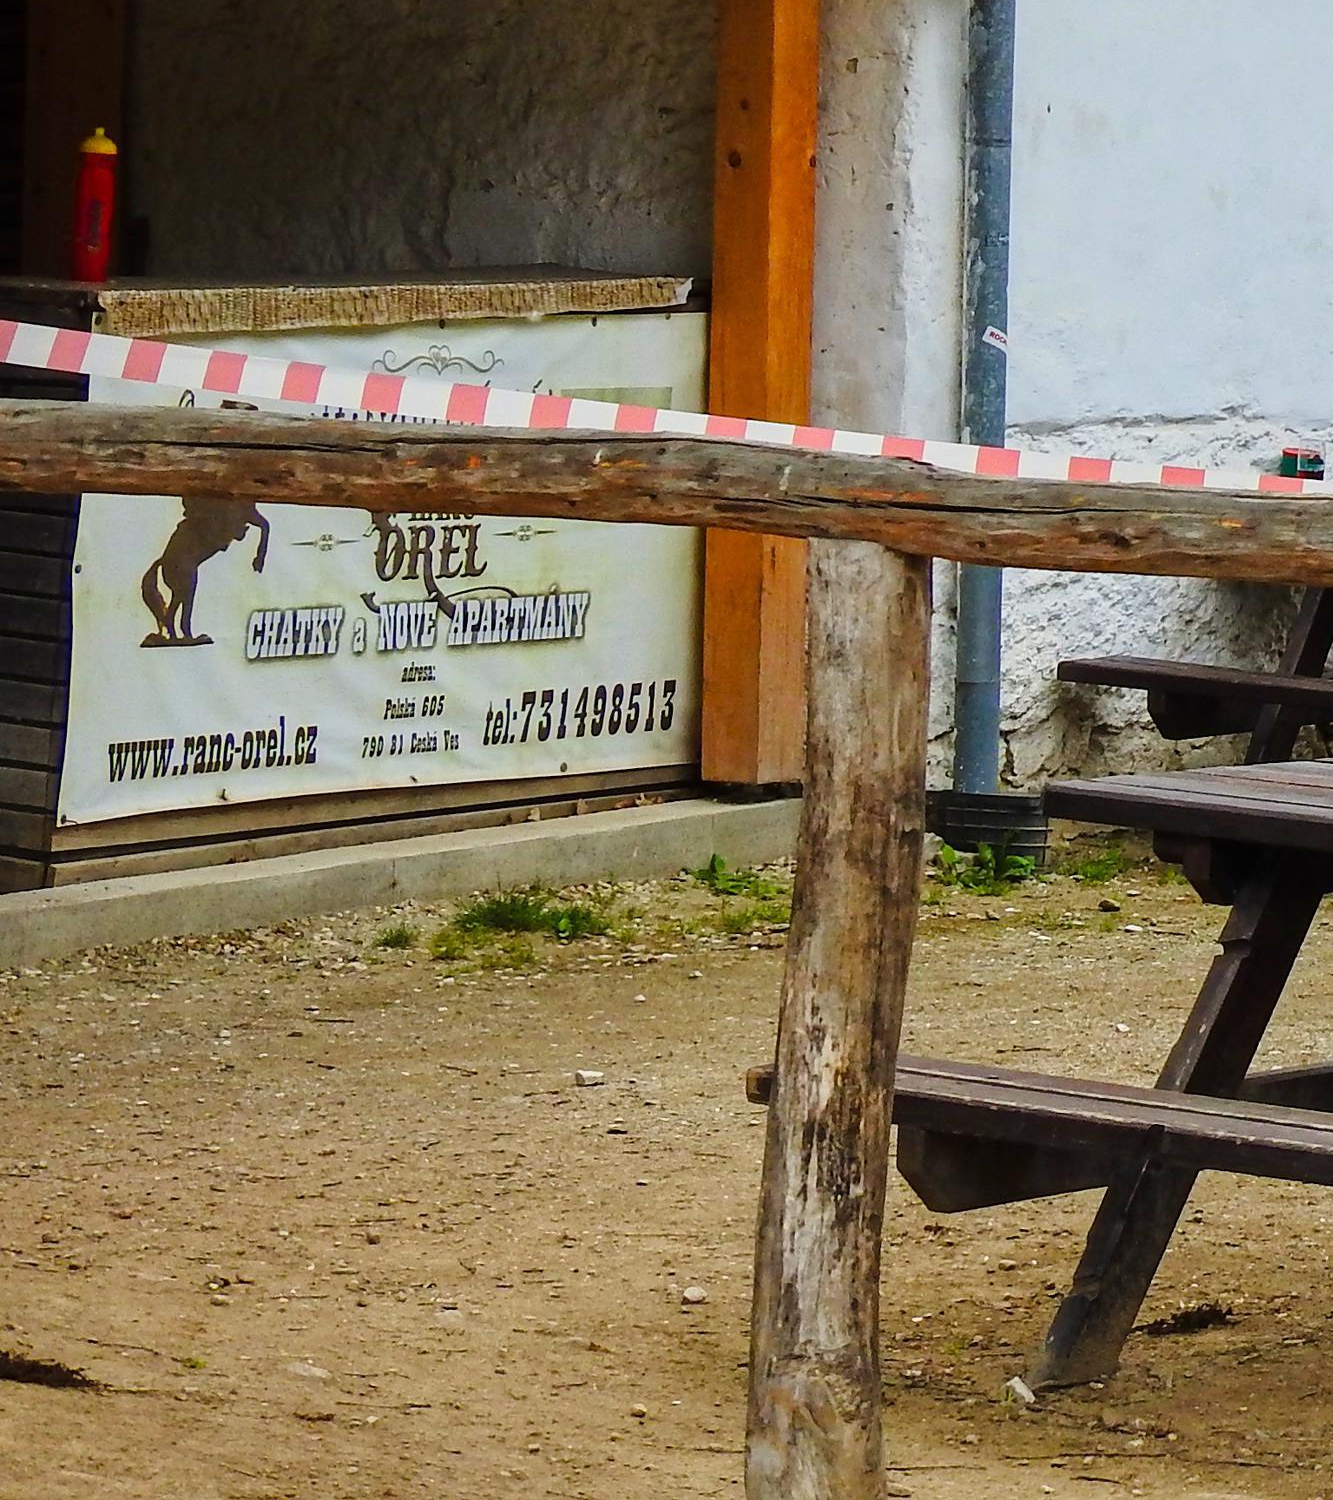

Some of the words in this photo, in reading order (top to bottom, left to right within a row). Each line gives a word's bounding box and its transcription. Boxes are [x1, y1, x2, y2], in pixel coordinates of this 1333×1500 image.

[371, 523, 488, 582] OREL
[247, 606, 344, 659] CHATKY
[353, 617, 367, 652] a
[447, 583, 590, 646] APARTMÁNY
[401, 661, 436, 683] adresa:
[383, 697, 416, 720] Polská
[421, 695, 445, 717] 605
[483, 680, 677, 747] tel:731498513
[108, 715, 318, 783] www.ranc-orel.cz
[361, 736, 385, 758] 790
[389, 734, 404, 755] 81
[443, 730, 460, 751] Ves
